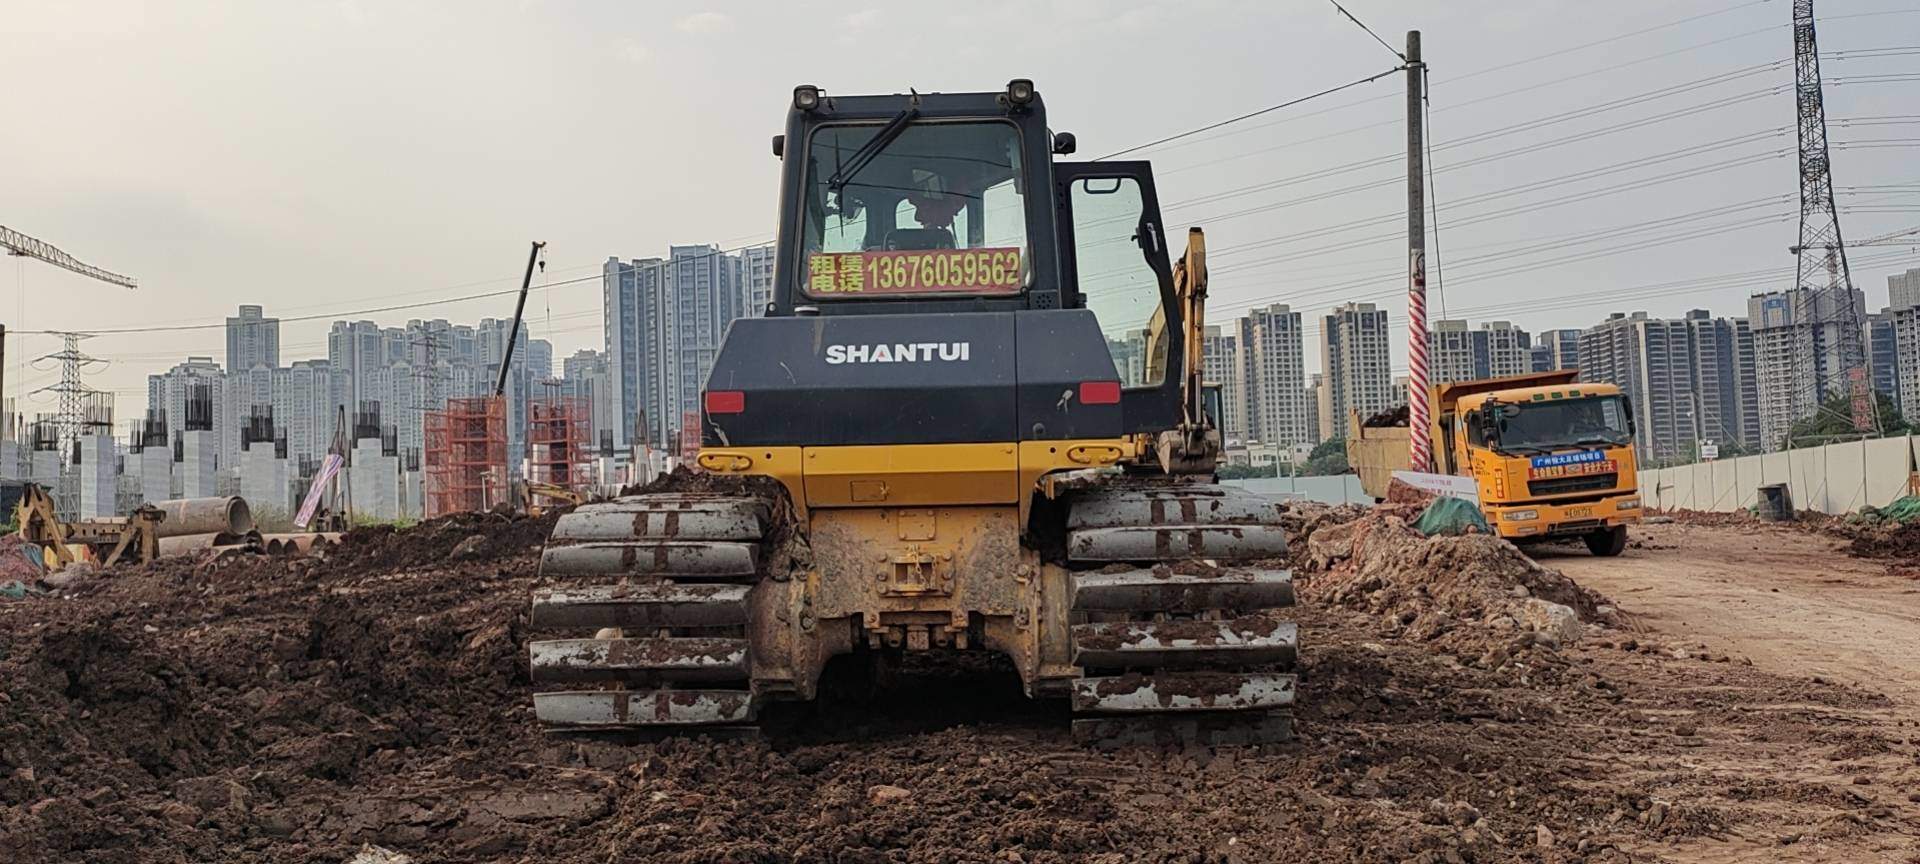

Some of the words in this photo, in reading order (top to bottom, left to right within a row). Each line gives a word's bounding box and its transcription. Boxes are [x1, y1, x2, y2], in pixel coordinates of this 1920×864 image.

[811, 255, 864, 273] 租赁
[868, 252, 1019, 289] 13676059562
[811, 273, 864, 292] 电话
[825, 342, 970, 364] SHANTUI
